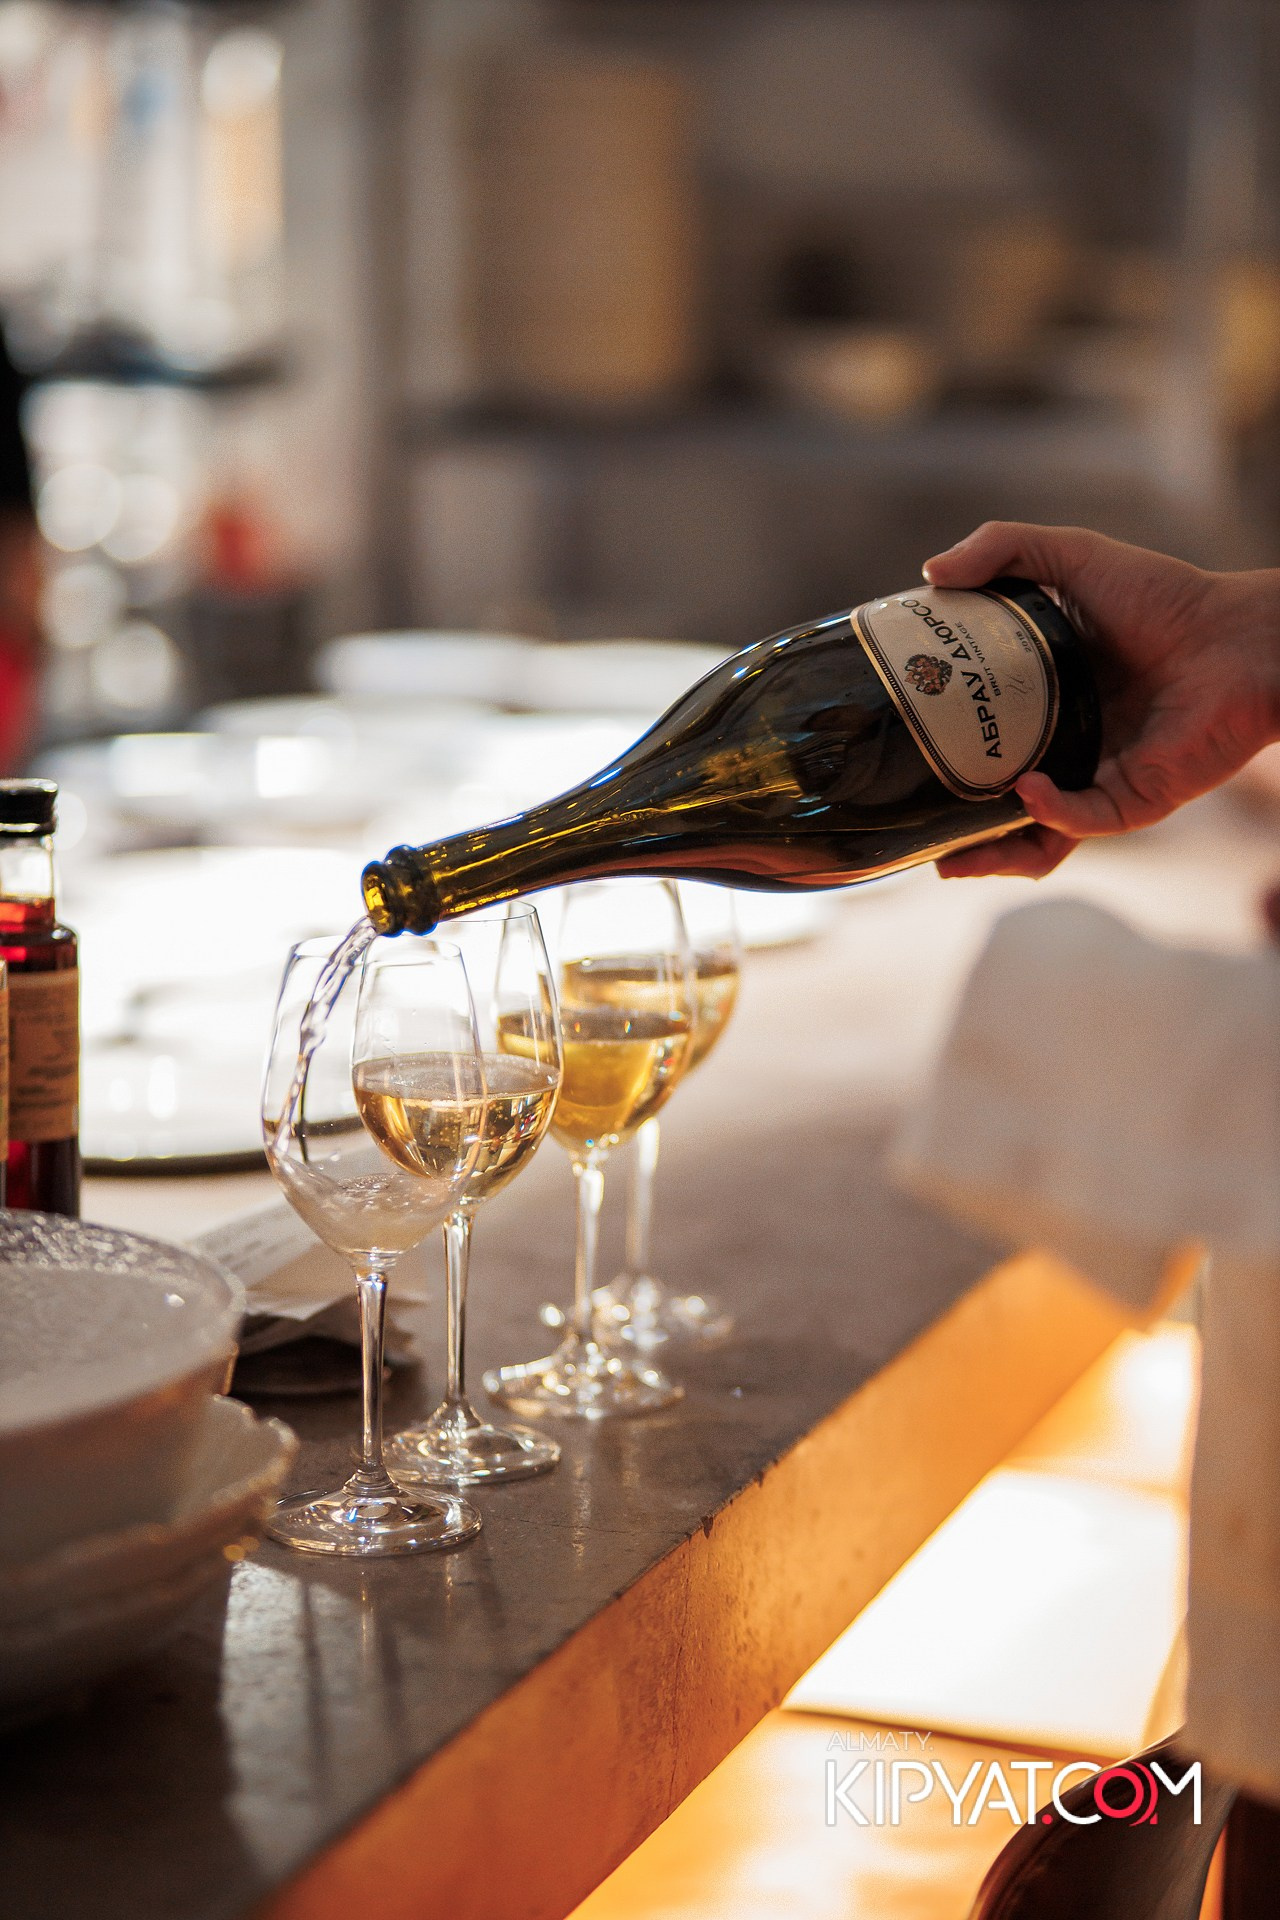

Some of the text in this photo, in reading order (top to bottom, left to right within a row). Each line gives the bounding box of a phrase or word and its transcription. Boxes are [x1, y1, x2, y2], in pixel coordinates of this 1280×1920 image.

[901, 599, 972, 661] ДЮРСО
[954, 621, 986, 663] VINTAGE
[1015, 630, 1032, 653] 2018
[983, 666, 1001, 697] BRUT
[961, 670, 1002, 758] АБРАУ
